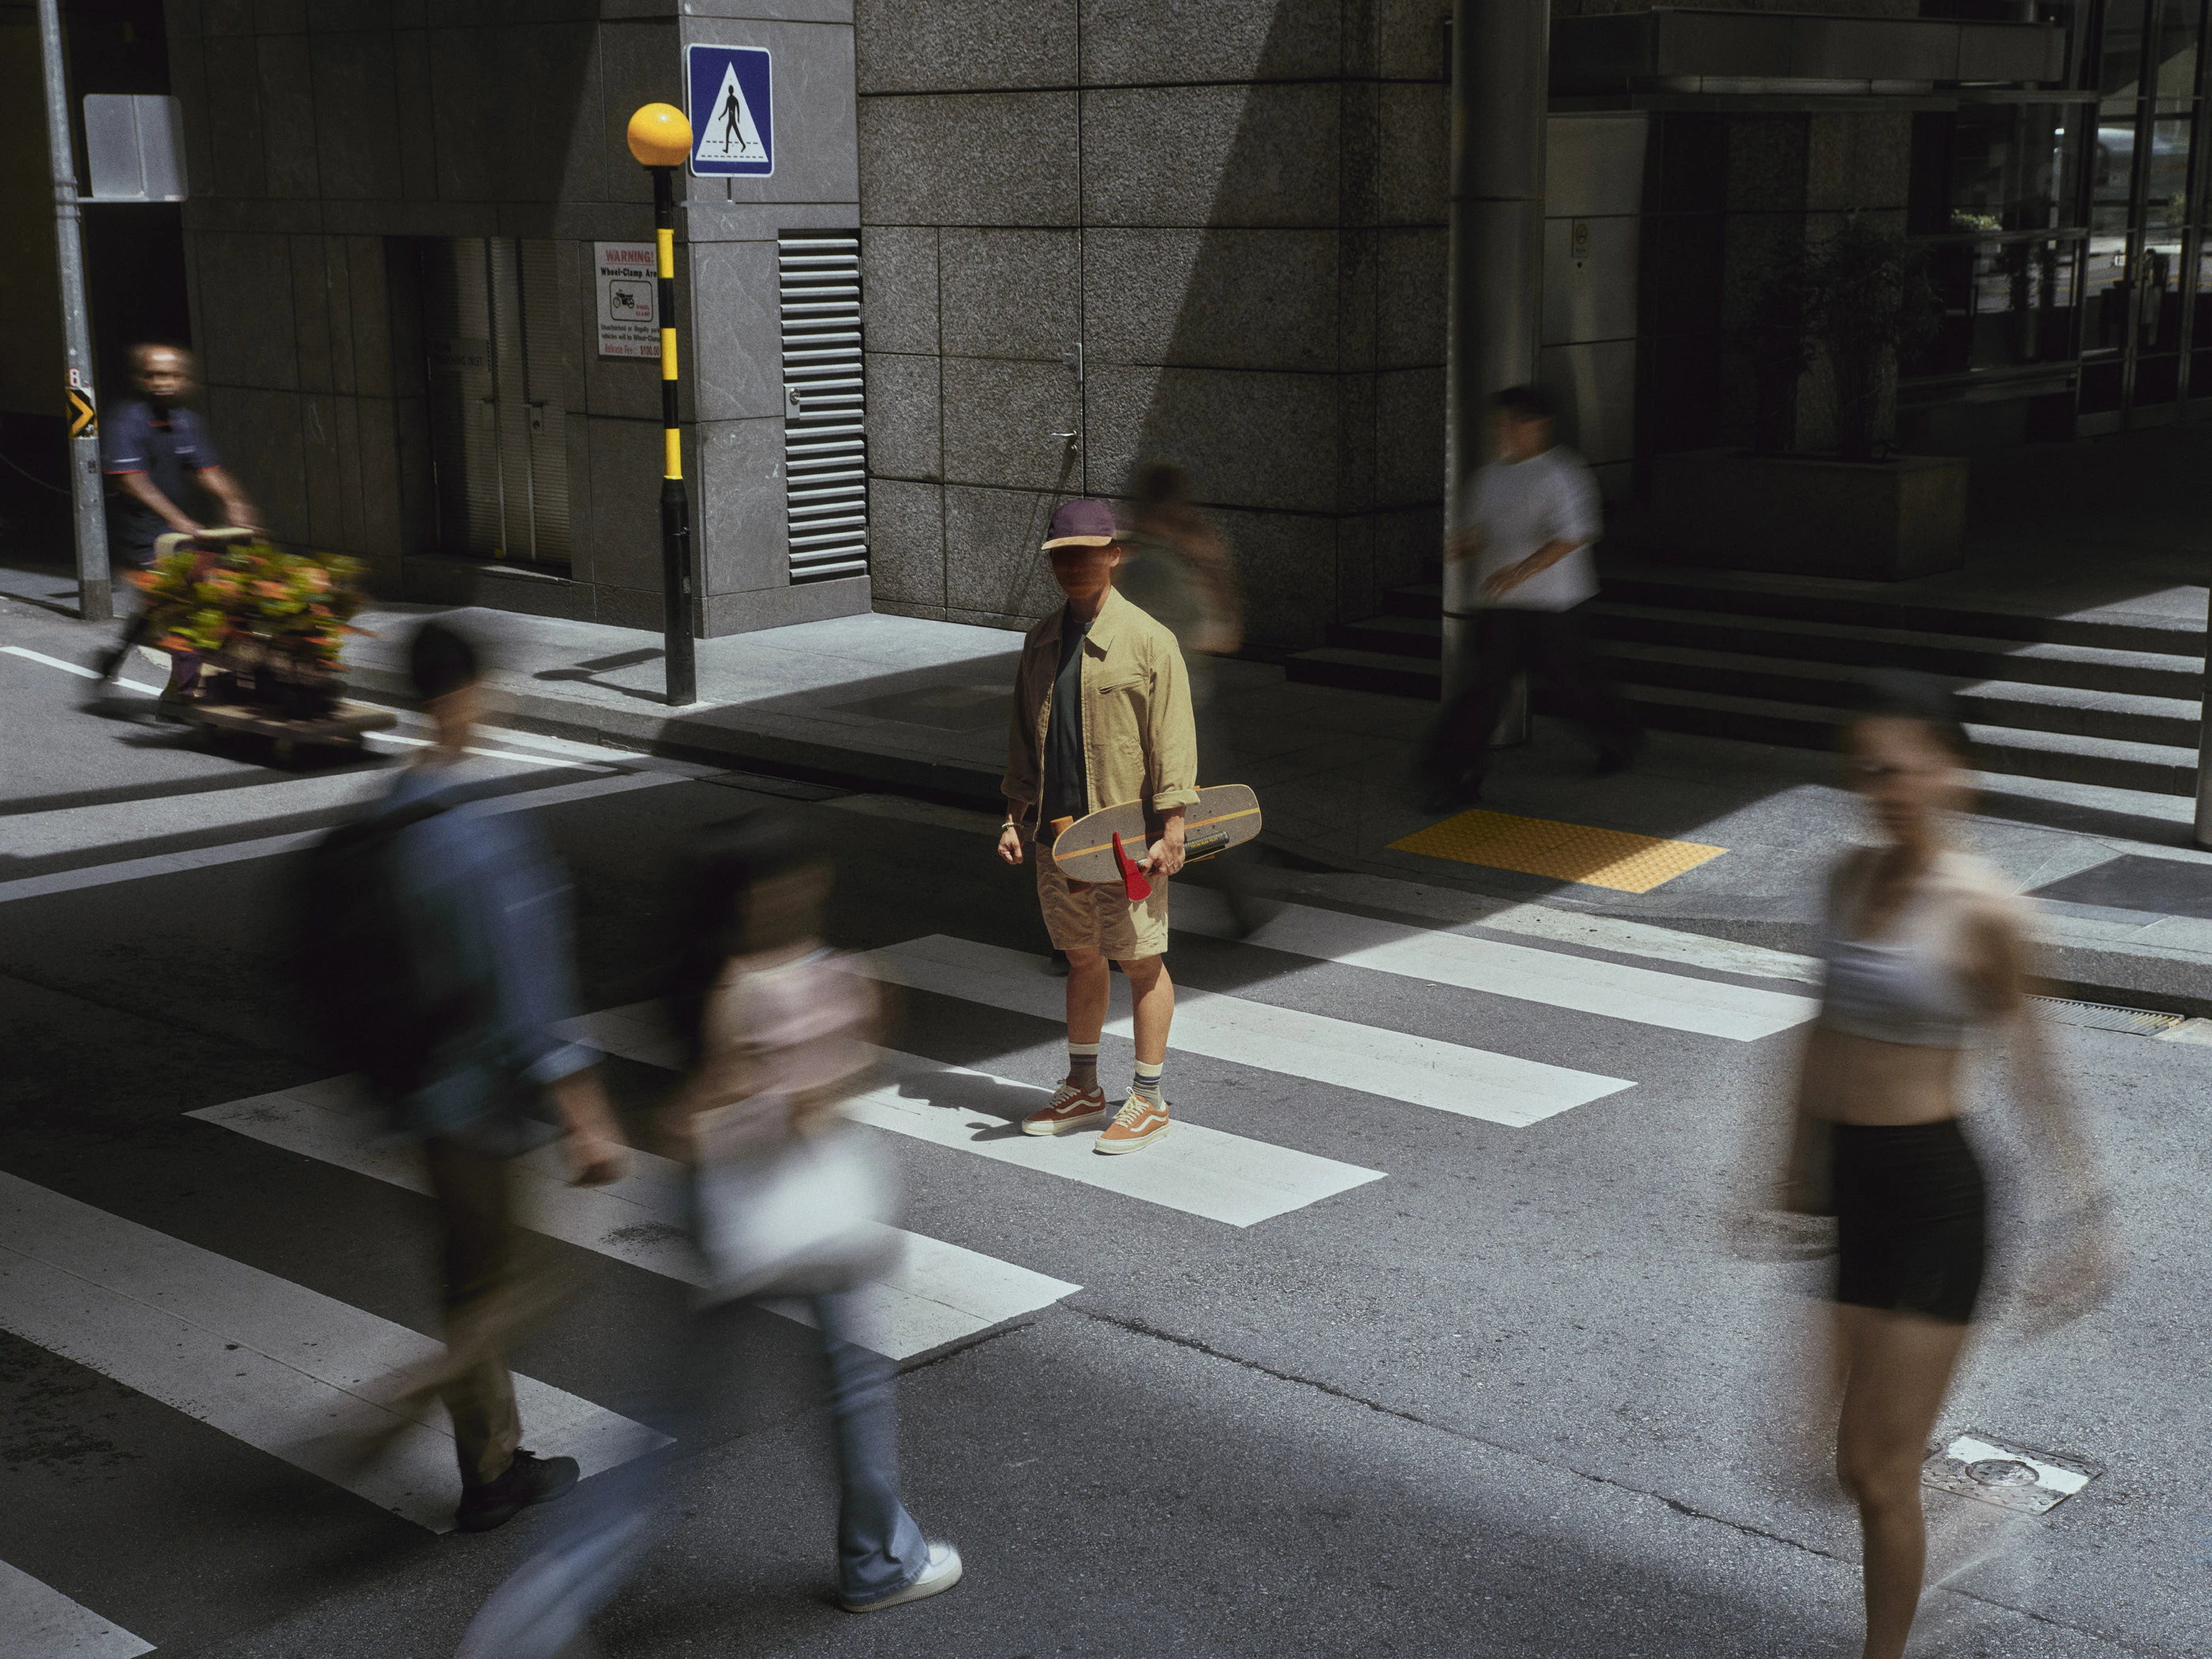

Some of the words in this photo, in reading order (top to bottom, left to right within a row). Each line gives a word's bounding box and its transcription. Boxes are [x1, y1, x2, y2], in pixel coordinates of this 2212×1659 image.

[605, 249, 654, 263] WARNING!
[600, 266, 642, 278] Wheel-Clamp
[645, 269, 657, 277] Are
[604, 343, 623, 354] Release
